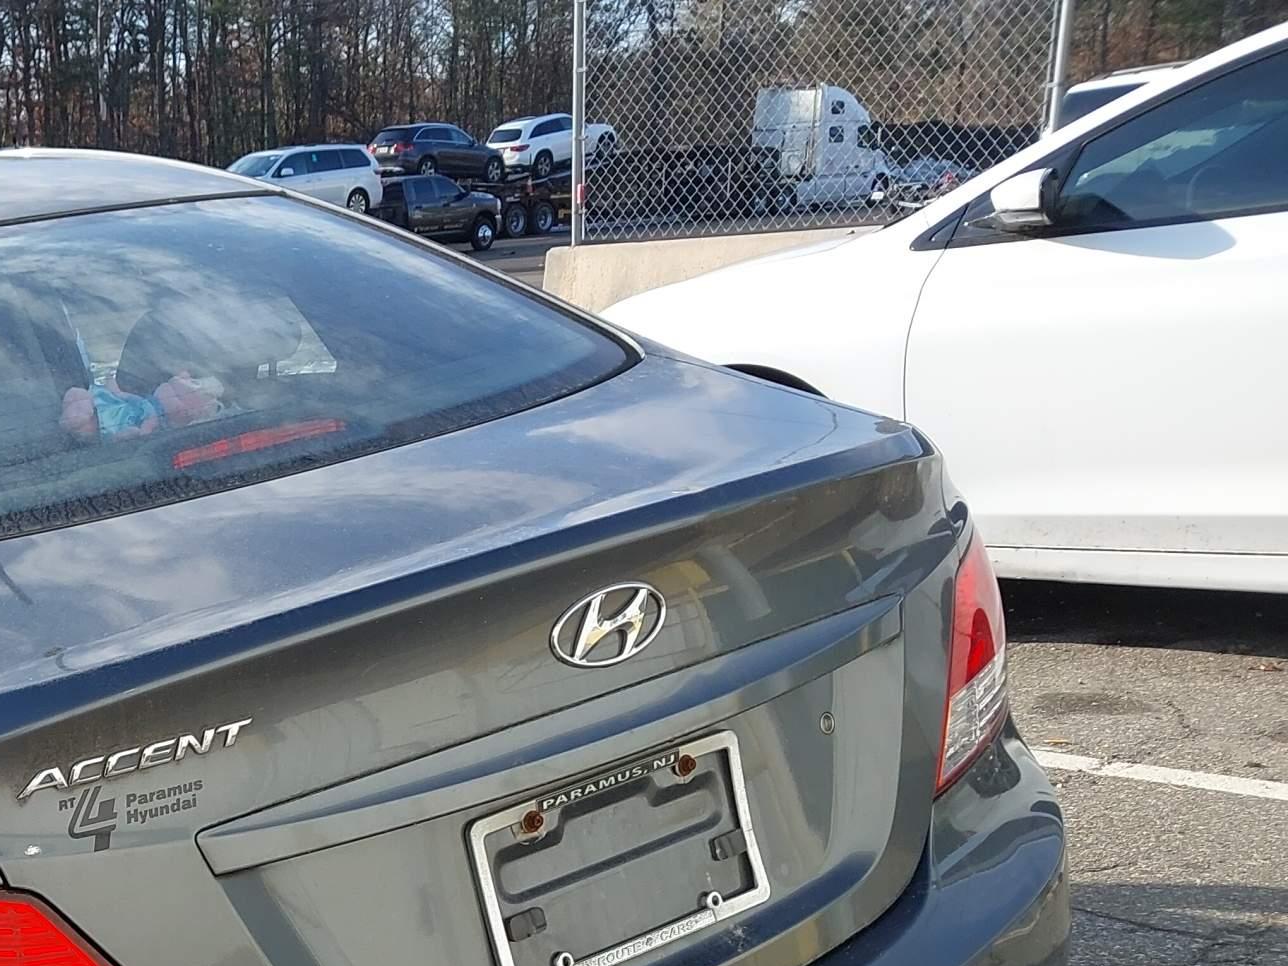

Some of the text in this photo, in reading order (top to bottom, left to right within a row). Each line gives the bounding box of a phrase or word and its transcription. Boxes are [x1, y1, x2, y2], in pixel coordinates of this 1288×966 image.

[16, 717, 253, 800] ACCENT
[542, 754, 675, 810] PARAMUS, NJ
[58, 785, 117, 852] RT 4
[125, 779, 203, 808] Paramus
[126, 793, 197, 824] Hyundai
